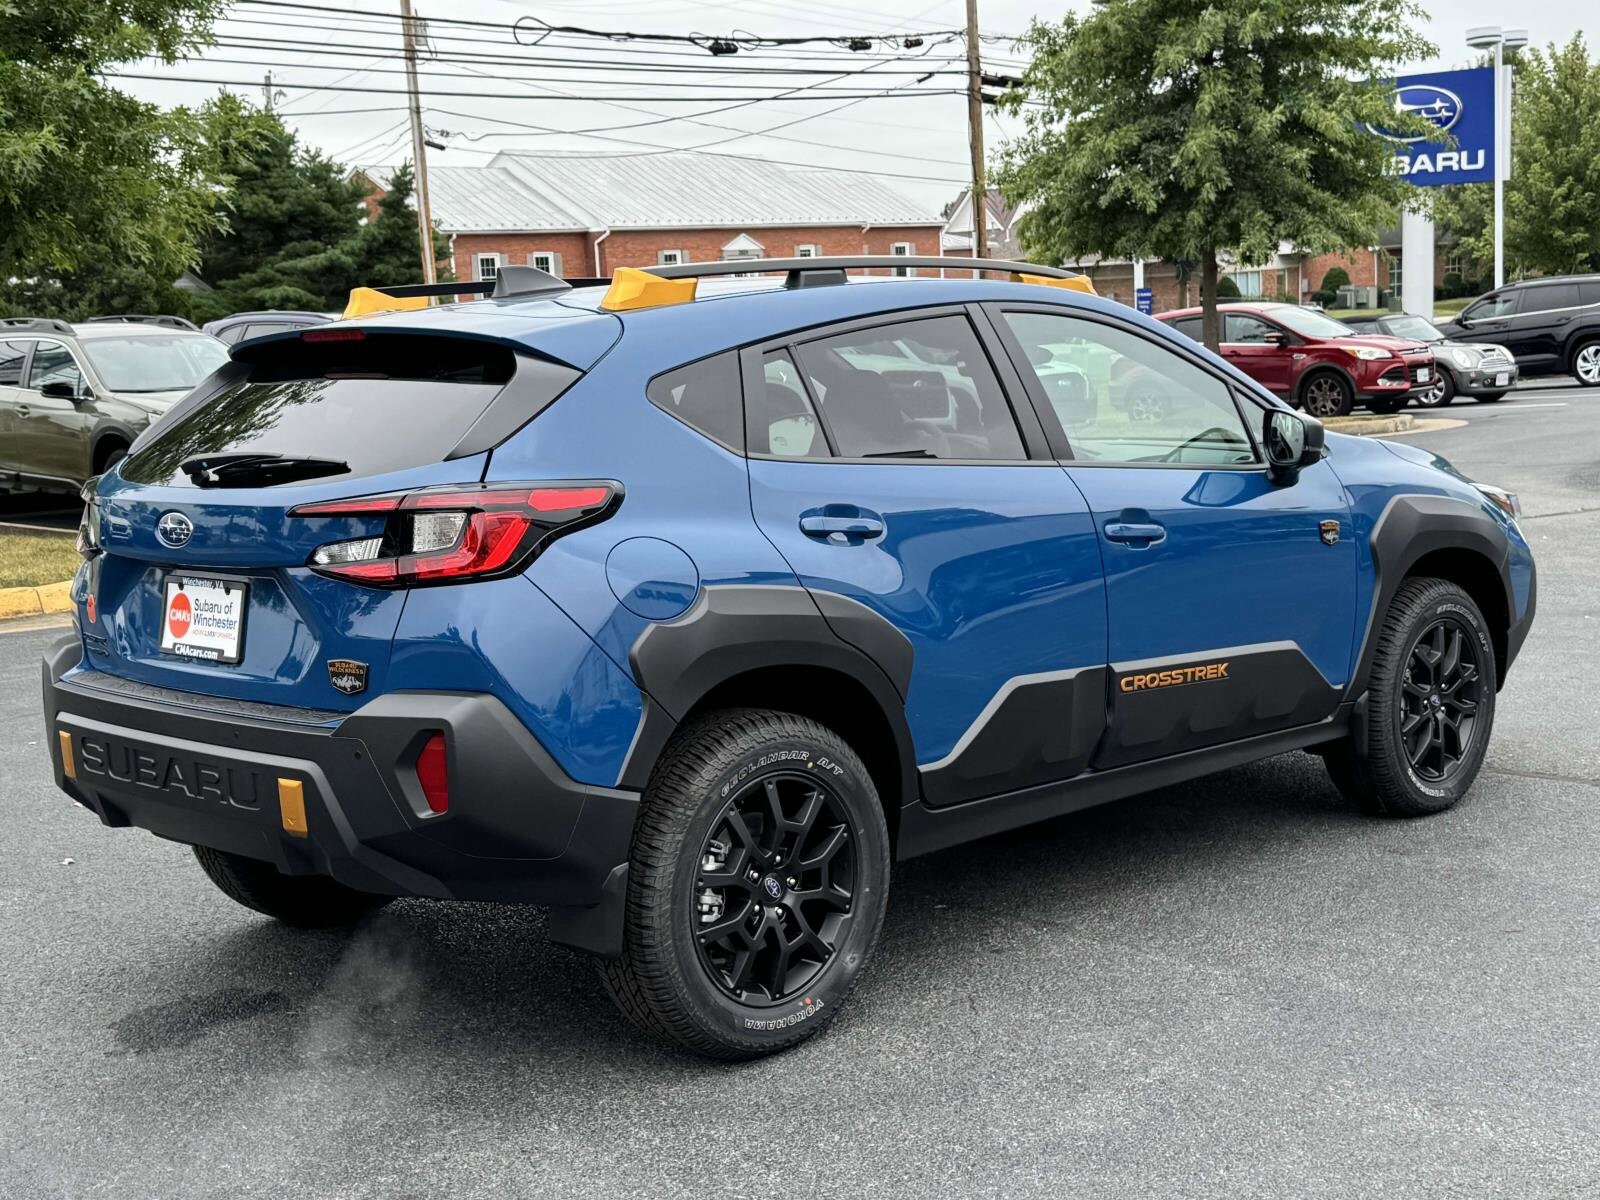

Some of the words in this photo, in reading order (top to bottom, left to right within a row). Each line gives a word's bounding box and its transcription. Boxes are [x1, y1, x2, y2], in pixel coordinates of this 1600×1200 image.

[1381, 149, 1485, 176] BARU
[194, 599, 222, 613] Subaru
[224, 602, 233, 615] of
[194, 613, 237, 630] Winchester
[175, 644, 218, 659] CMAcars.com
[1120, 662, 1229, 692] CROSSTREK
[82, 737, 262, 811] SUBARU
[721, 750, 810, 797] GEOLANDAR
[816, 757, 844, 776] A/T
[744, 998, 825, 1031] YOKOHAMA
